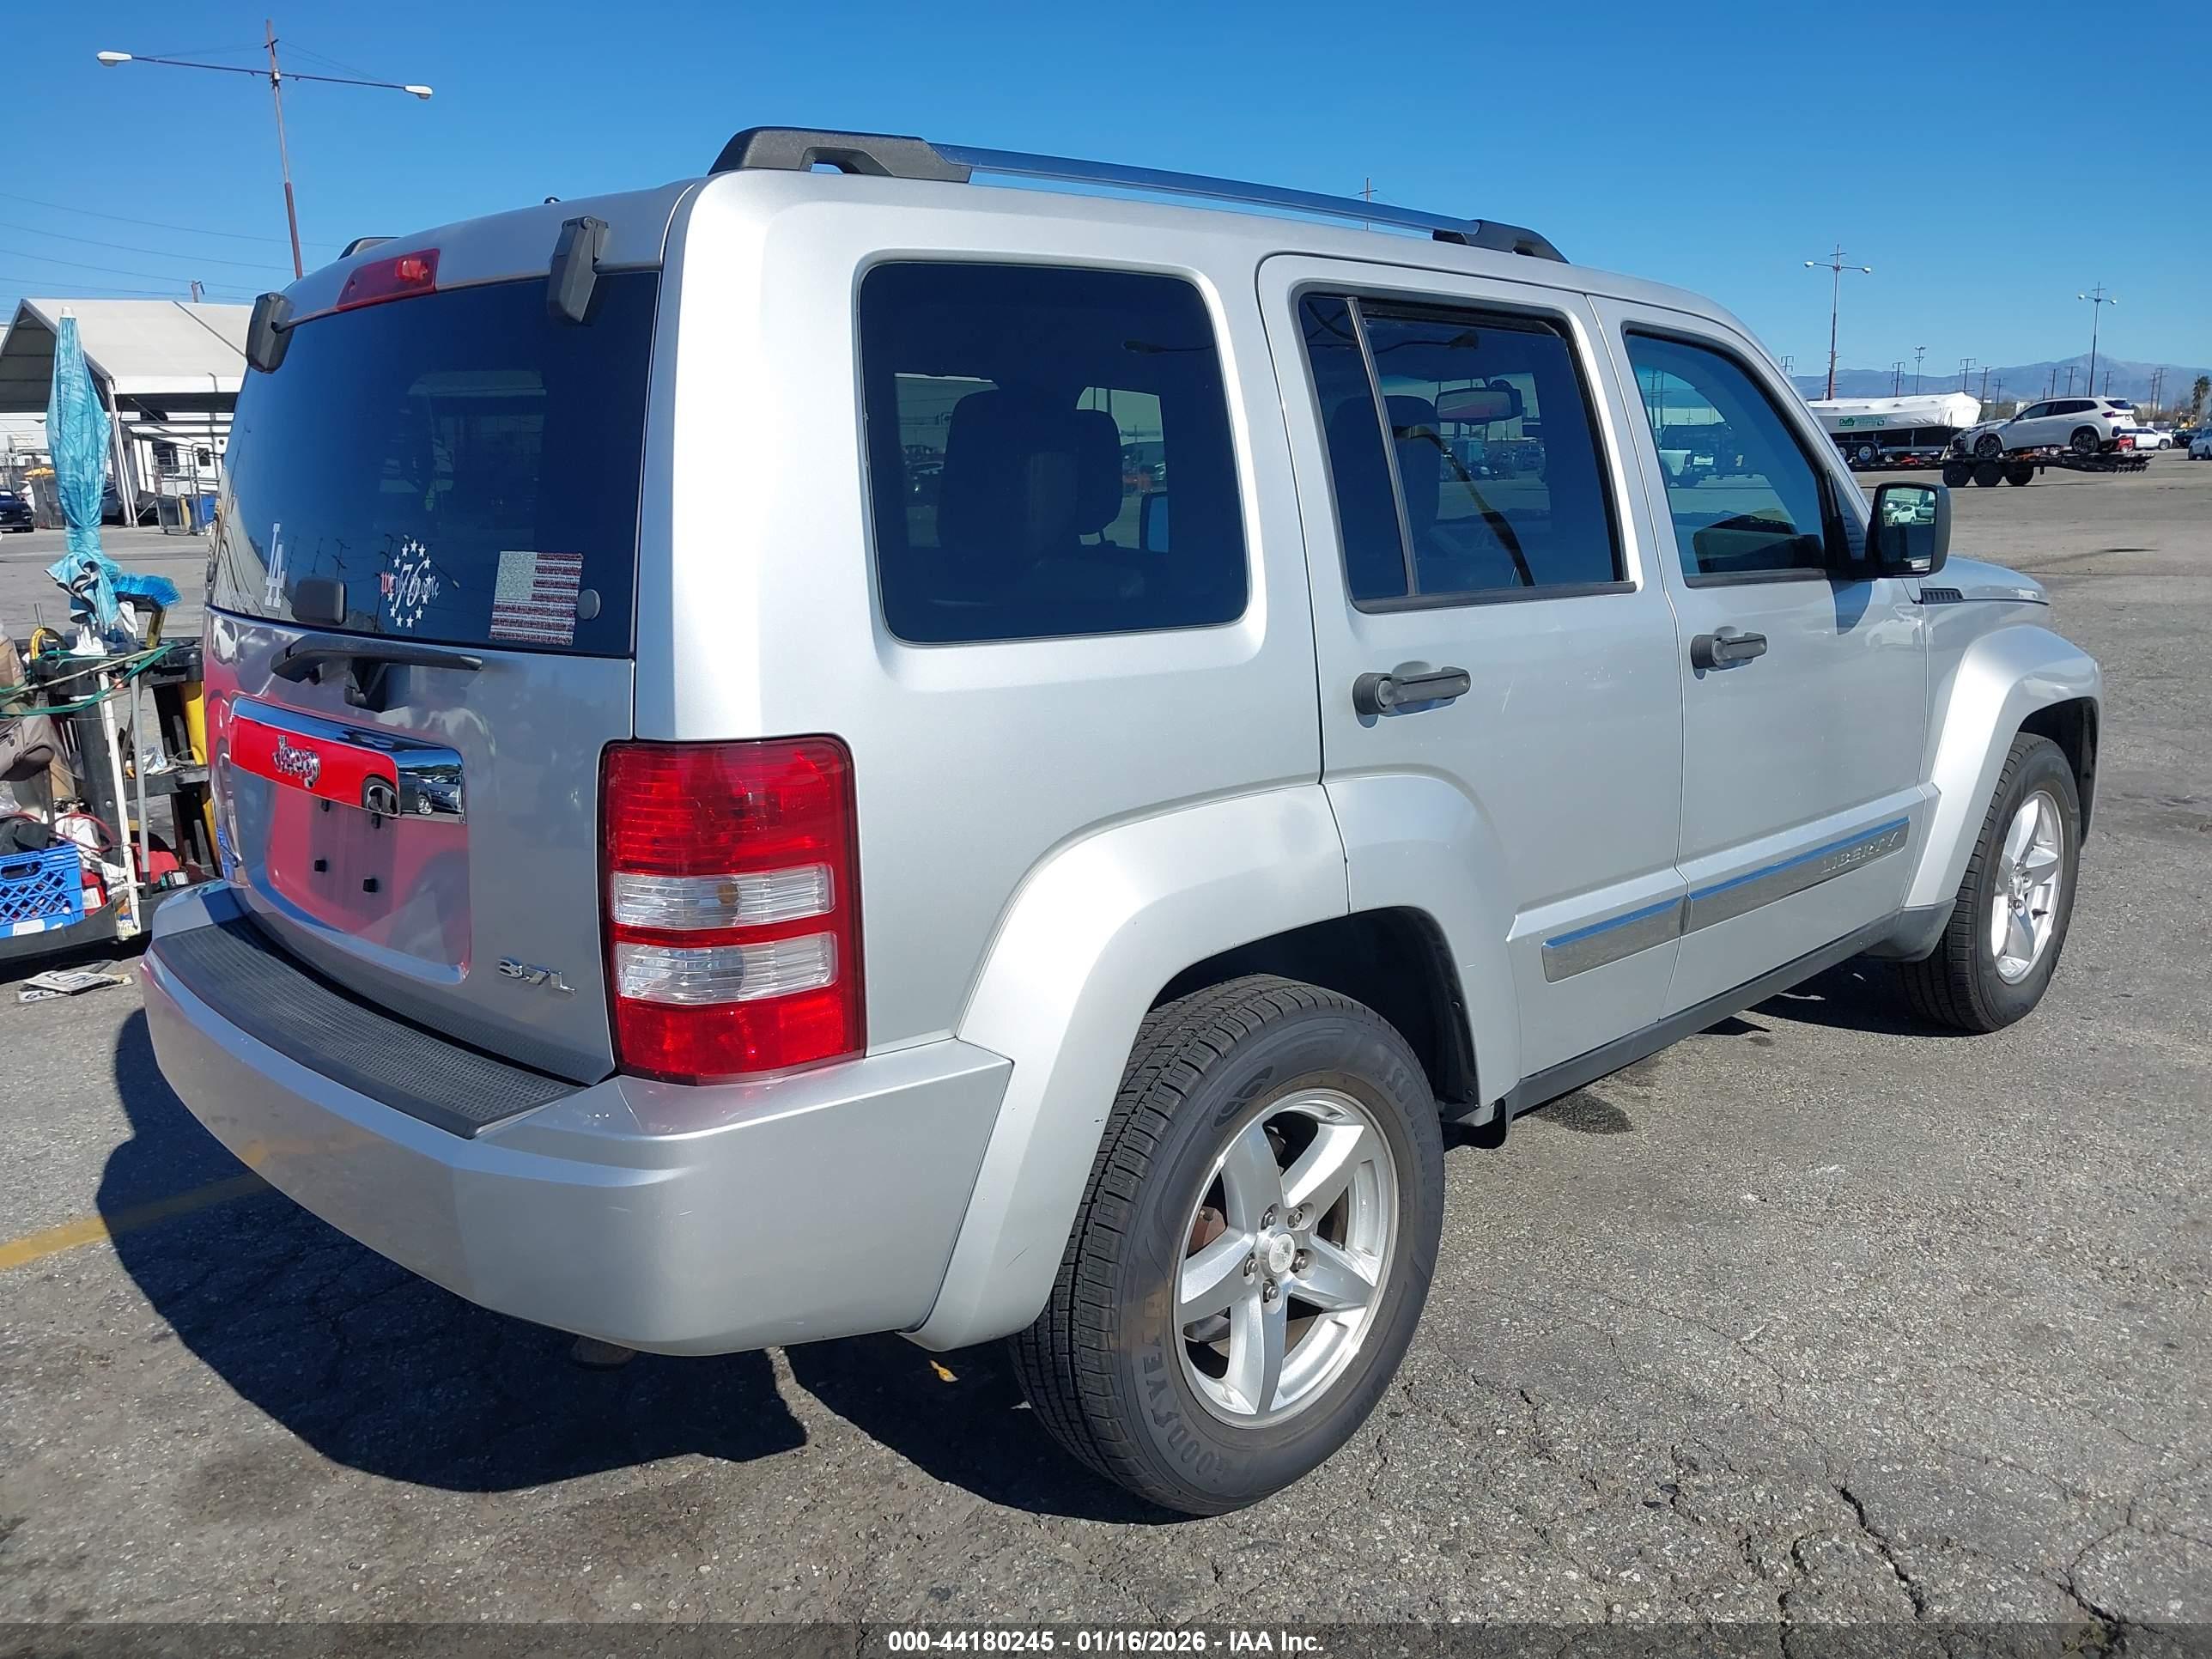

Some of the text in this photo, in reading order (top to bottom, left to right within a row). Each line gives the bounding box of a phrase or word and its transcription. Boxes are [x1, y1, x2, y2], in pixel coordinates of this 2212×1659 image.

[1839, 417, 1855, 427] Duffy
[272, 735, 320, 788] Jeep
[1820, 831, 1899, 874] LIBERTY
